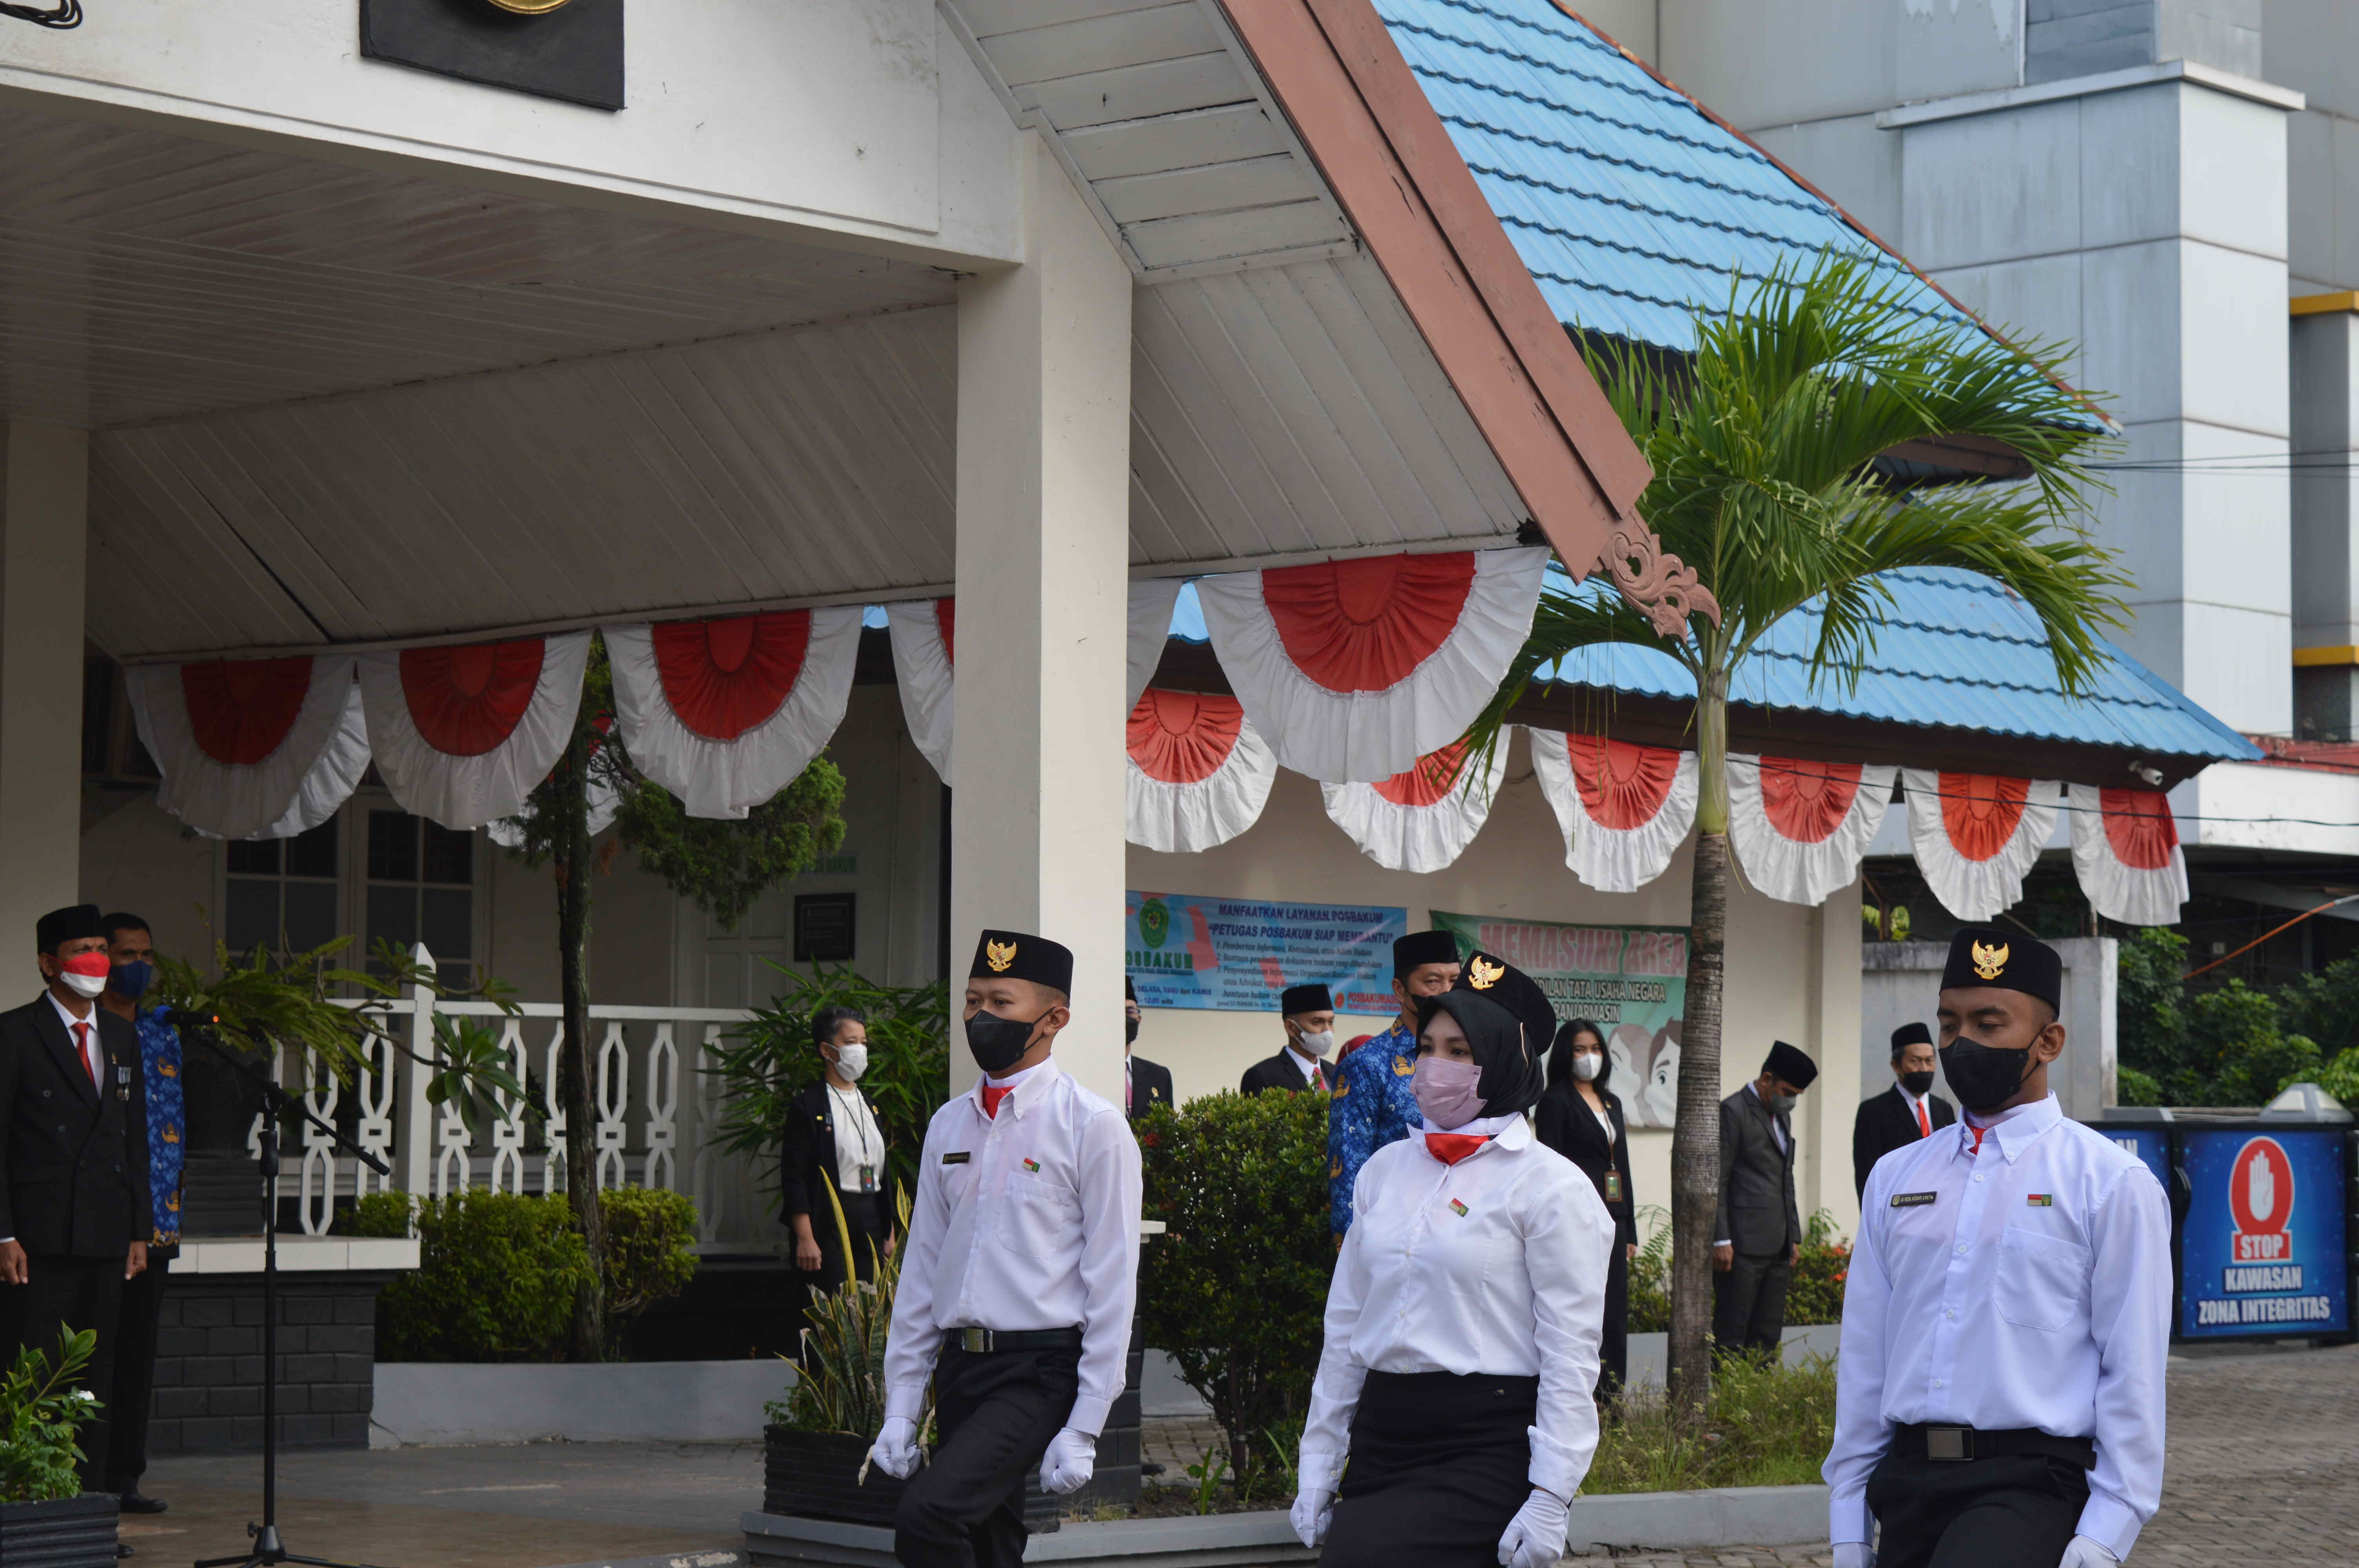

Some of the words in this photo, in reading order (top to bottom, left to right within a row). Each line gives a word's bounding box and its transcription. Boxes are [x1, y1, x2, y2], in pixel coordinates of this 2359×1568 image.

[1218, 904, 1283, 918] MANFAATKAN
[1286, 908, 1330, 921] LAYANAN
[1332, 911, 1383, 923] POSBAKUM
[1260, 926, 1312, 940] POSBAKUM
[1315, 929, 1335, 940] SIAP
[1223, 942, 1255, 950] Pemberian
[1478, 923, 1623, 973] MEMASUKI
[1623, 931, 1687, 976] AREA
[1125, 950, 1193, 969] OSBAKUM
[1223, 954, 1249, 962] Bantuan
[1285, 956, 1312, 965] dokumen
[1313, 958, 1333, 967] hukum
[1239, 978, 1263, 987] Advokat
[1568, 980, 1592, 999] TATA
[1594, 980, 1626, 1000] USAHA
[1627, 982, 1666, 1003] NEGARA
[1223, 990, 1249, 998] bantuan
[1250, 991, 1270, 999] hukum
[1553, 1002, 1620, 1023] BANJARMASIN
[2241, 1234, 2283, 1258] STOP
[2225, 1266, 2302, 1292] KAWASAN
[2199, 1300, 2239, 1324] ZONA
[2241, 1296, 2330, 1323] INTEGRITAS
